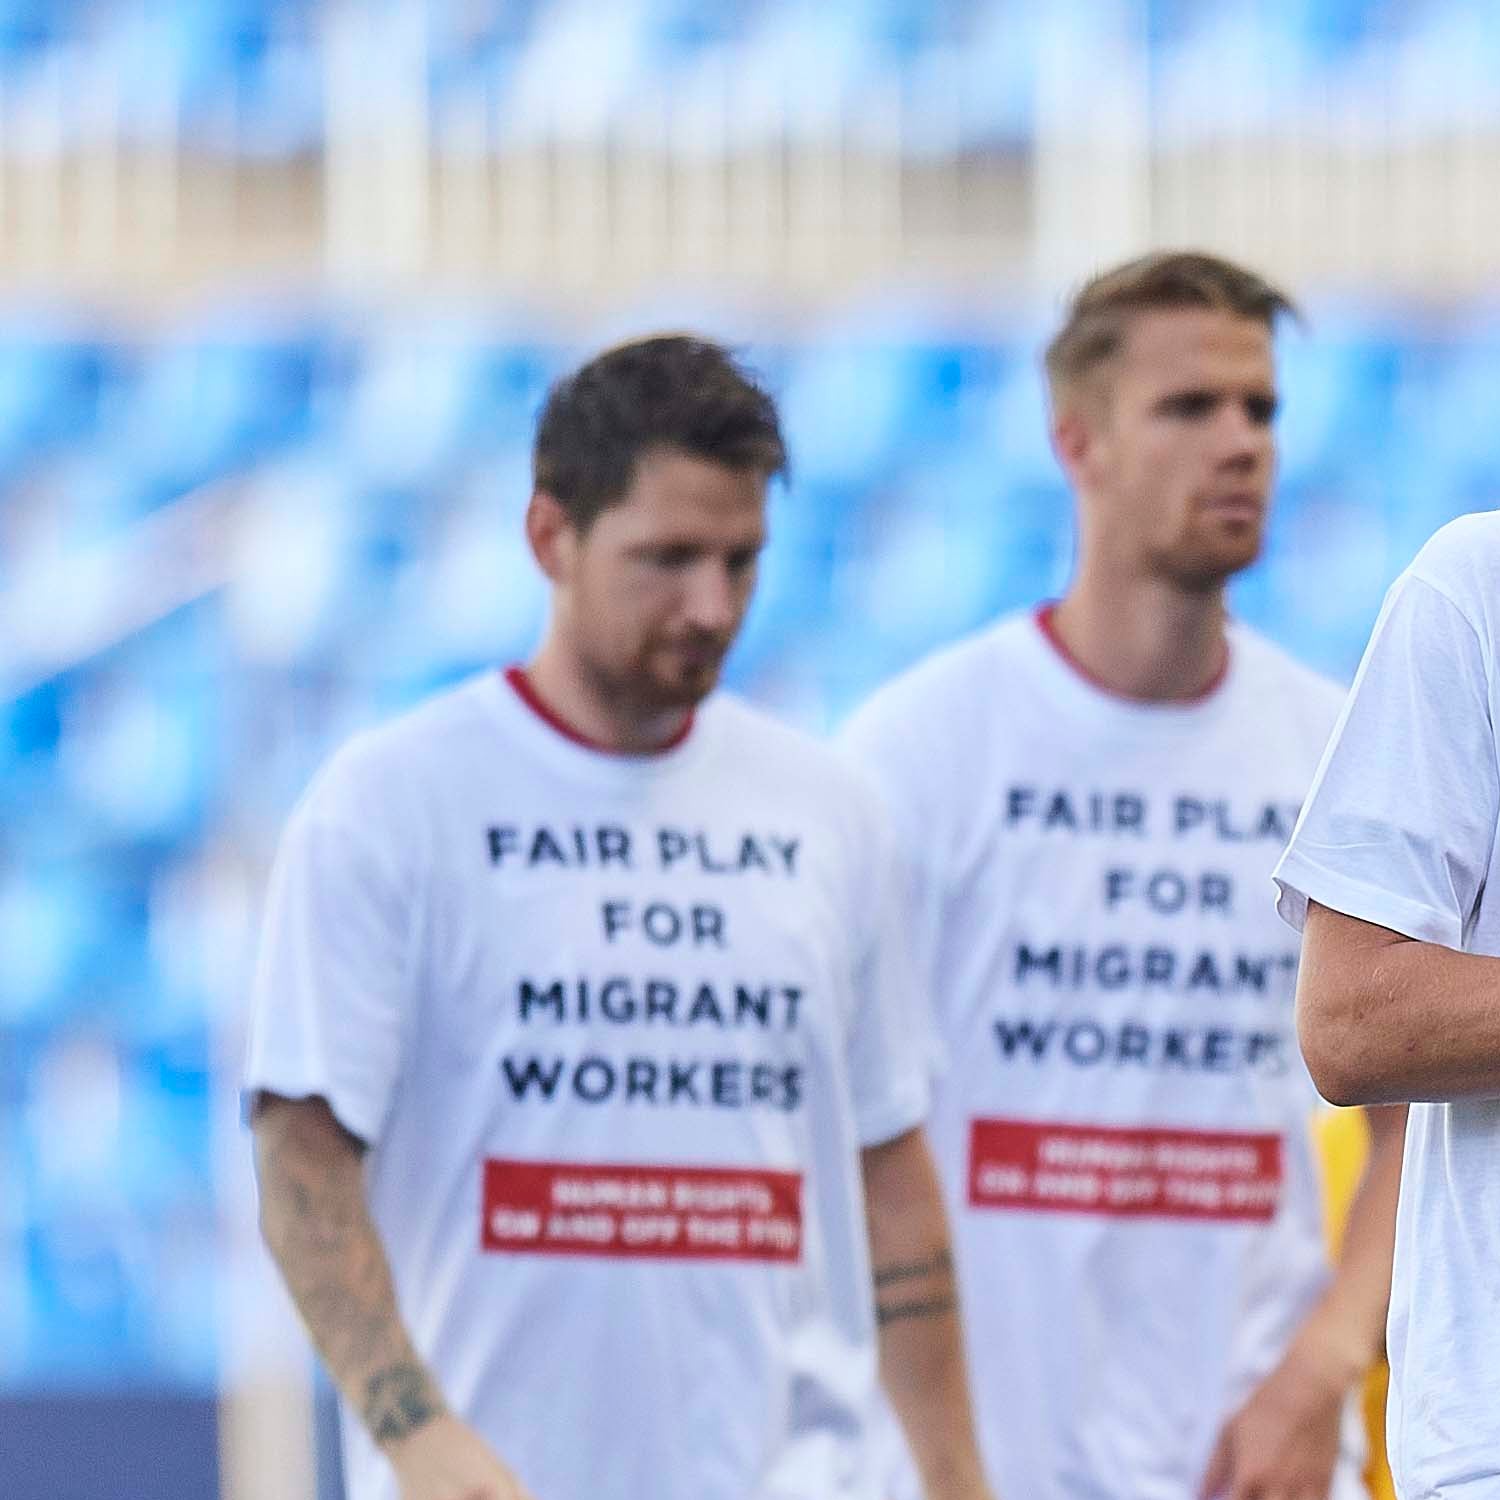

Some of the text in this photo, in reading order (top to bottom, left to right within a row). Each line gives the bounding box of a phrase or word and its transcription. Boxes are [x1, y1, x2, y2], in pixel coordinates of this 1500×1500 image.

[1007, 789, 1299, 842] FAIR PLA
[486, 826, 801, 877] FAIR PLAY
[1106, 870, 1232, 914] FOR
[602, 901, 726, 948] FOR
[517, 977, 806, 1031] MIGRANT
[501, 1056, 803, 1112] WORKERS
